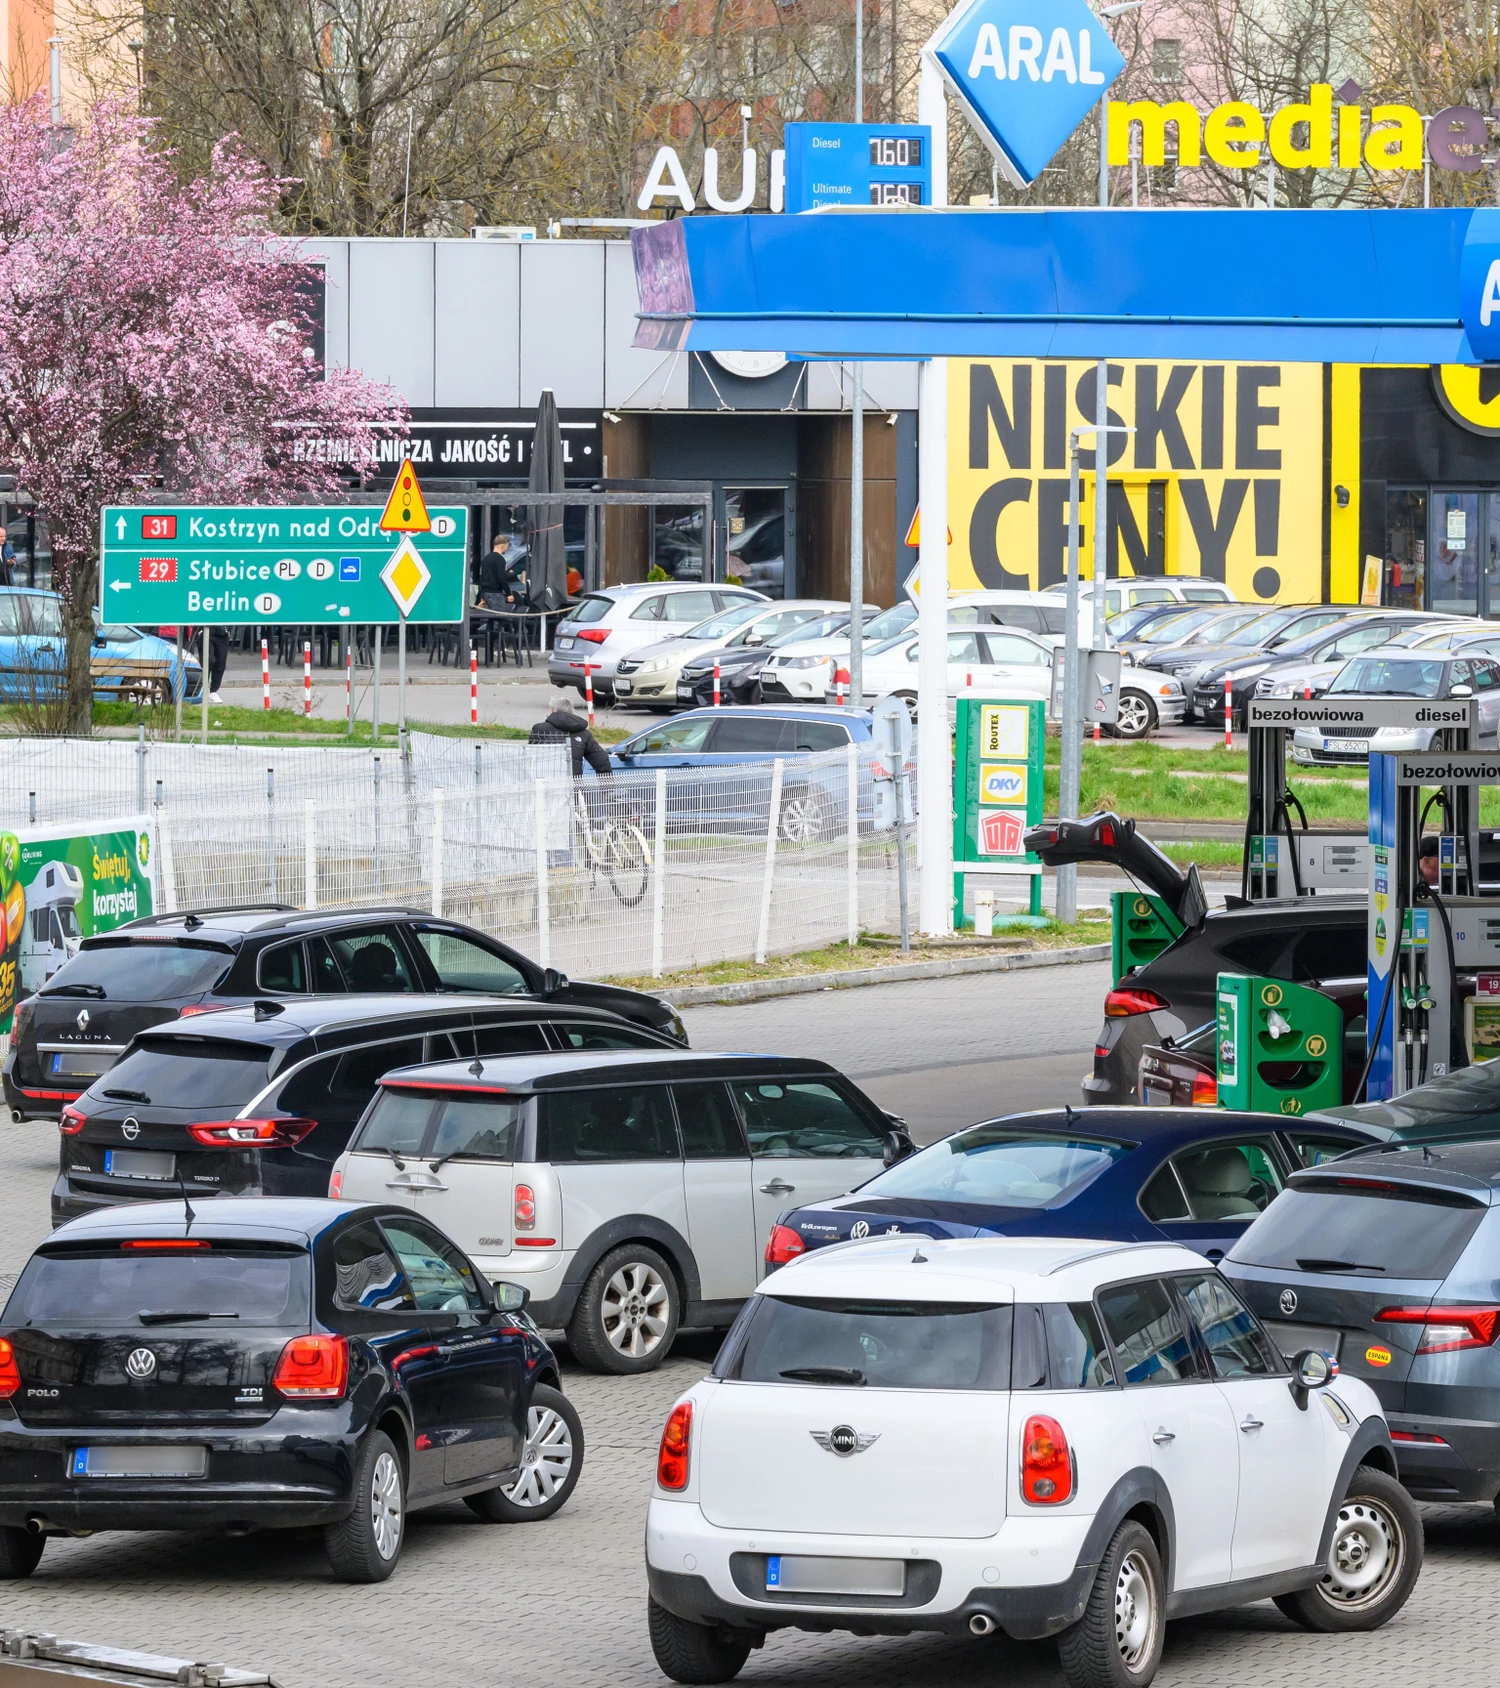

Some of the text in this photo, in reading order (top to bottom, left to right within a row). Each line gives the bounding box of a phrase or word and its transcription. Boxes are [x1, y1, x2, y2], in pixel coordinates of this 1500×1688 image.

[967, 22, 1105, 85] ARAL
[812, 137, 840, 149] Diesel
[812, 183, 852, 194] Ultimate
[968, 363, 1282, 471] NISKIE
[440, 434, 511, 463] JAKOŚĆ
[517, 440, 523, 462] I
[150, 519, 168, 535] 31
[189, 517, 280, 543] Kostrzyn
[290, 516, 330, 537] nad
[438, 519, 447, 533] D
[968, 477, 1282, 599] CENY!
[148, 563, 169, 578] 29
[188, 559, 326, 581] Słubice PL D
[188, 591, 272, 612] Berlin D
[1252, 706, 1466, 721] bezołowiowa diesel
[988, 778, 1020, 791] DKV
[985, 816, 1022, 851] UTA
[92, 846, 131, 884] Świętuj,
[93, 883, 138, 920] korzystaj
[1456, 932, 1466, 941] 10
[1488, 980, 1499, 989] 19
[27, 1389, 59, 1397] POLO
[833, 1435, 856, 1445] MINI
